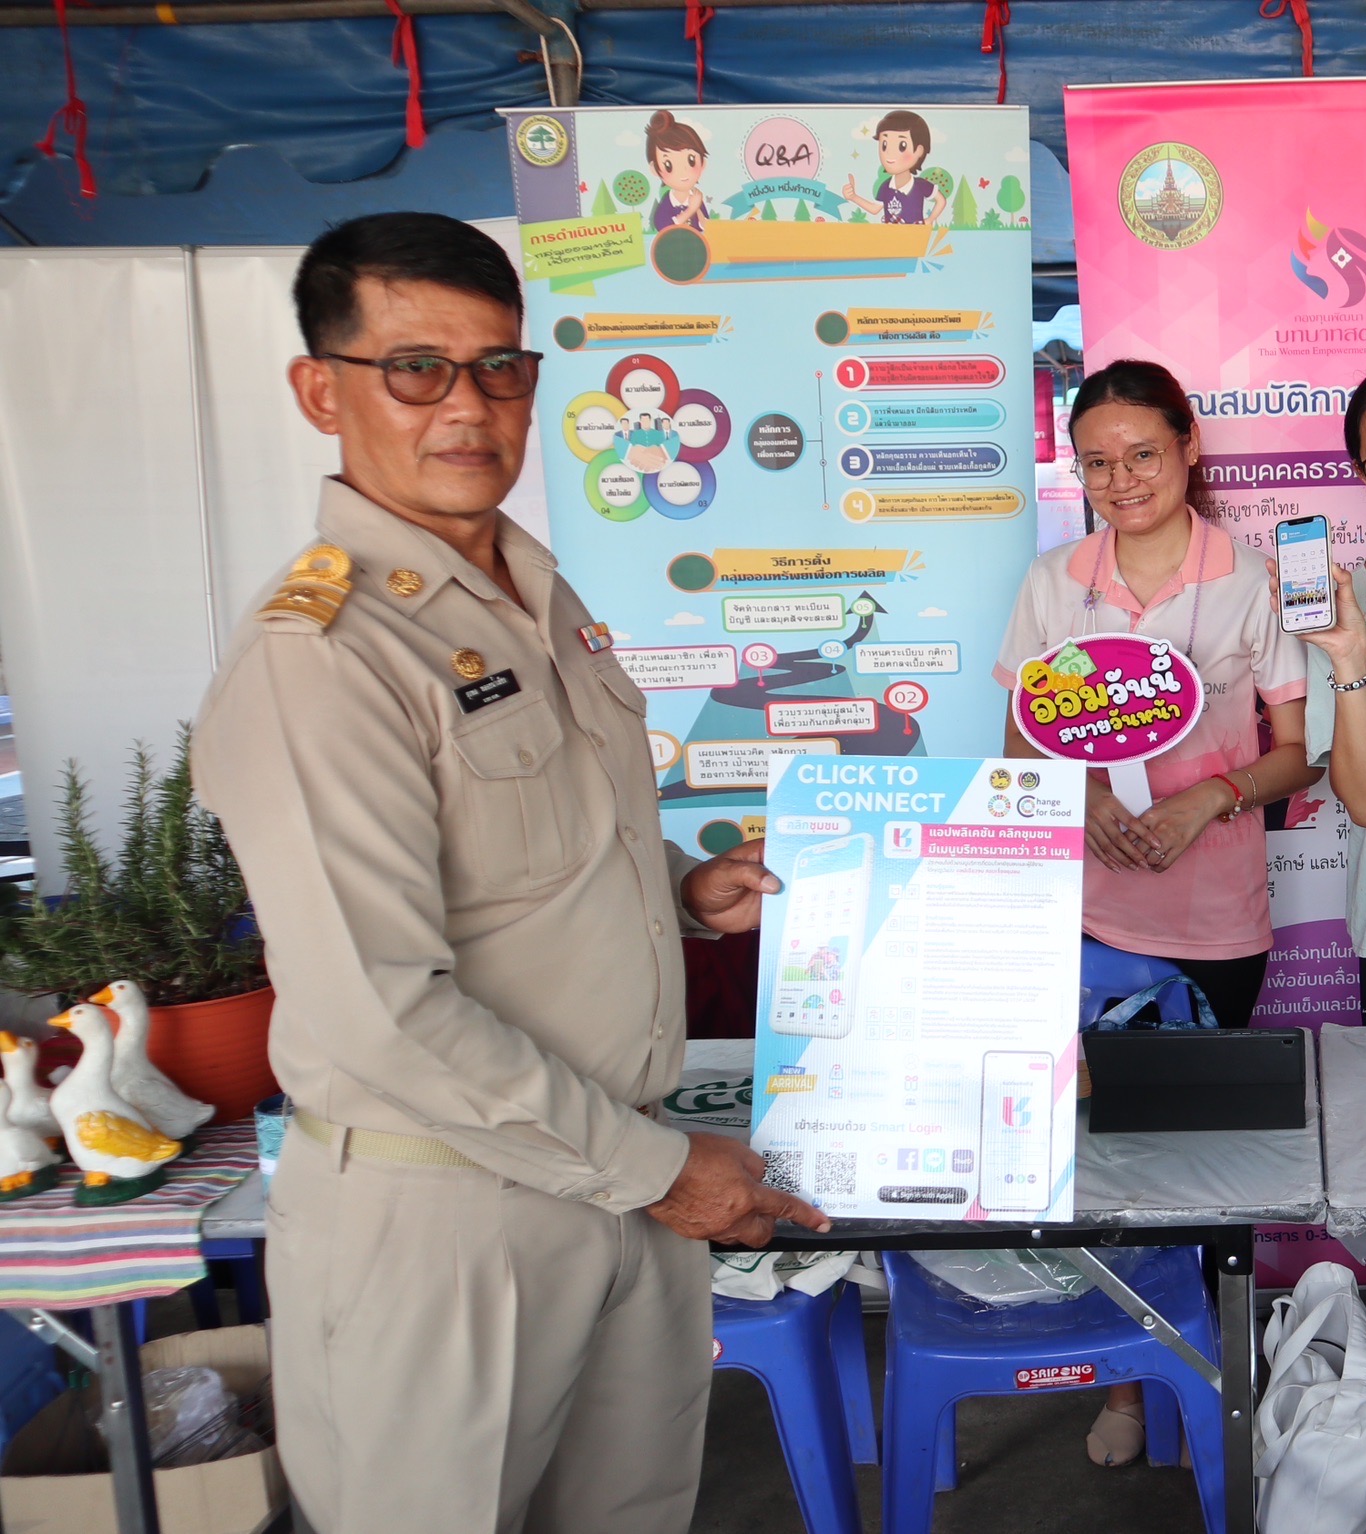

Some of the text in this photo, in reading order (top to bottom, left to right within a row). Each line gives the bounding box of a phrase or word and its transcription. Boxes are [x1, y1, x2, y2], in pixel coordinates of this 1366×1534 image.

[755, 143, 813, 168] Q&A
[530, 222, 626, 246] การดำเนินงาน
[1258, 348, 1277, 356] Thai
[1279, 348, 1310, 356] Women
[567, 411, 576, 419] 05
[713, 405, 723, 413] 02
[1245, 532, 1263, 548] 15
[771, 553, 831, 567] วิธีการตั้ง
[750, 650, 769, 662] 03
[824, 645, 841, 654] 04
[1029, 643, 1182, 724] ออมวันนี้
[894, 691, 917, 703] 02
[1058, 699, 1182, 745] สบายวันหน้า
[797, 763, 920, 786] CLICK TO
[815, 791, 945, 813] CONNECT
[1036, 809, 1071, 817] for Good
[786, 818, 839, 832] คลิกชุมชน
[929, 827, 1052, 841] แอปพลิเคชัน คลิกชุมชน
[928, 843, 1070, 859] มีเมนูบริการมากกว่า 13 เมนู
[771, 1077, 813, 1089] ARRIVAL
[795, 1119, 943, 1135] เข้าสู่ระบบด้วย Smart Login
[769, 1139, 798, 1147] Android
[823, 1202, 838, 1210] App
[1254, 1230, 1299, 1242] ทรสาร
